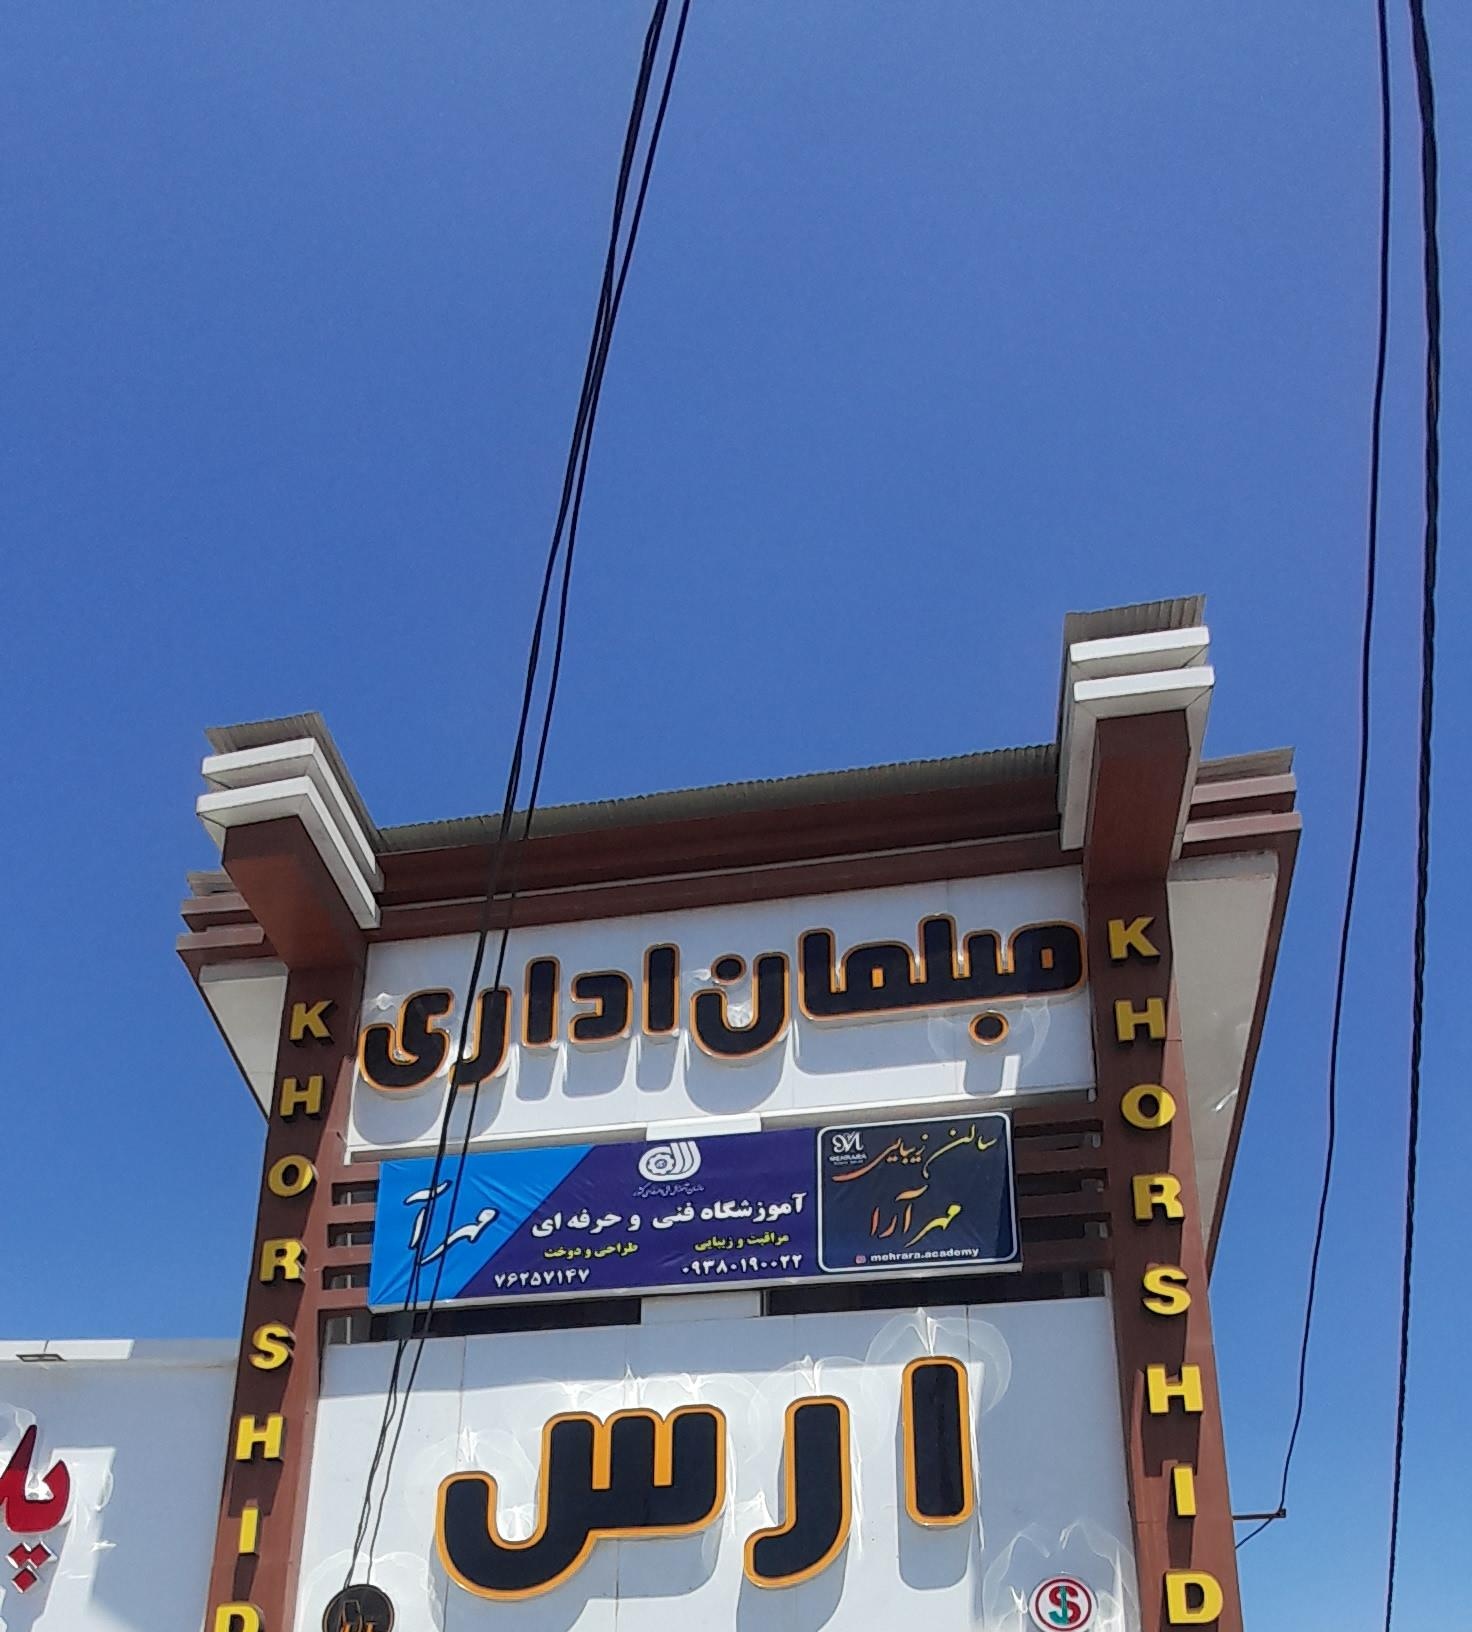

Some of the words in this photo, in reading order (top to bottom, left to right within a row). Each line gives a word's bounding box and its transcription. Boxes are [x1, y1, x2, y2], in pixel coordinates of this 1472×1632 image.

[357, 942, 681, 1092] اداری
[690, 913, 1088, 1059] مبلمان
[627, 1214, 642, 1232] و
[652, 1201, 696, 1230] فنی
[700, 1191, 808, 1223] آموزشگاه
[1107, 915, 1224, 1626] KHORSHID
[436, 1354, 974, 1600] ارس
